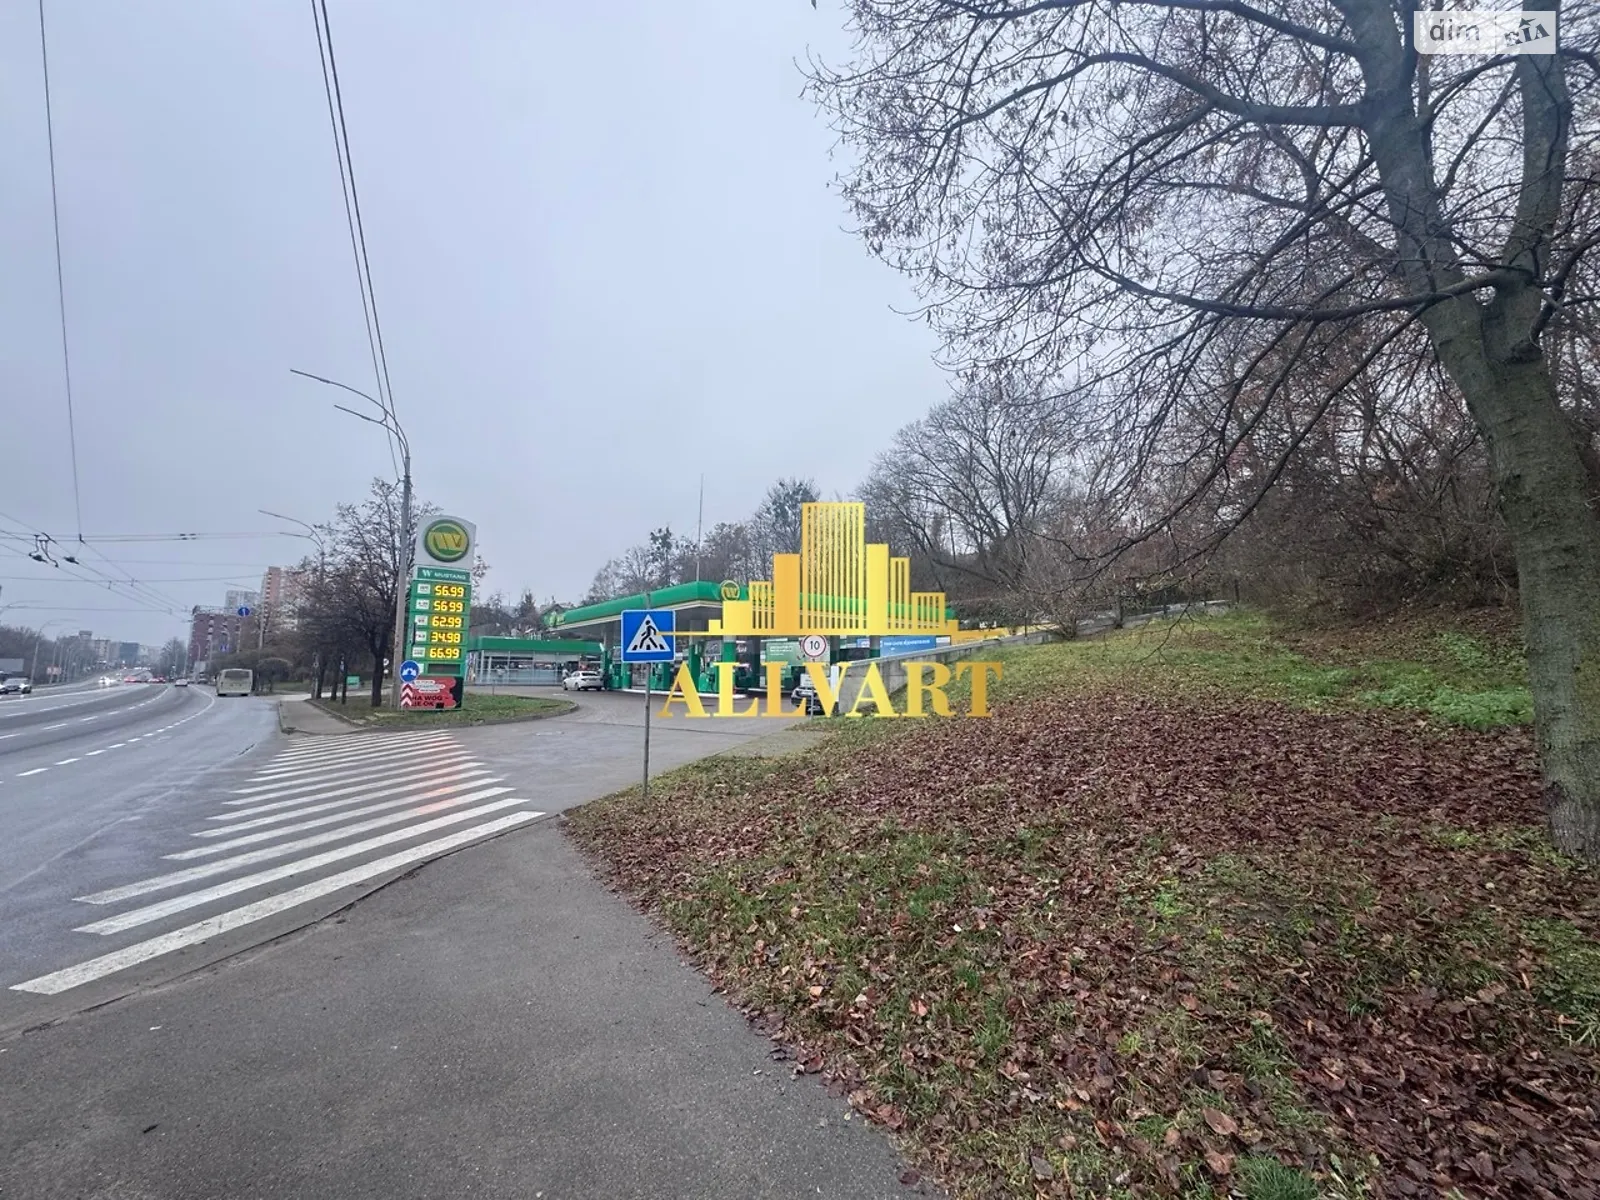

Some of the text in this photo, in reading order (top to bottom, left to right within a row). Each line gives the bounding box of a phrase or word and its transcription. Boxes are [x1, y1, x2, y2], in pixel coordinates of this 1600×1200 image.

[434, 571, 466, 580] MUSTANG
[434, 585, 465, 597] 56.99
[431, 616, 462, 628] 62.99
[431, 631, 461, 643] 34.98
[810, 641, 820, 650] 10
[429, 648, 460, 659] 66.99
